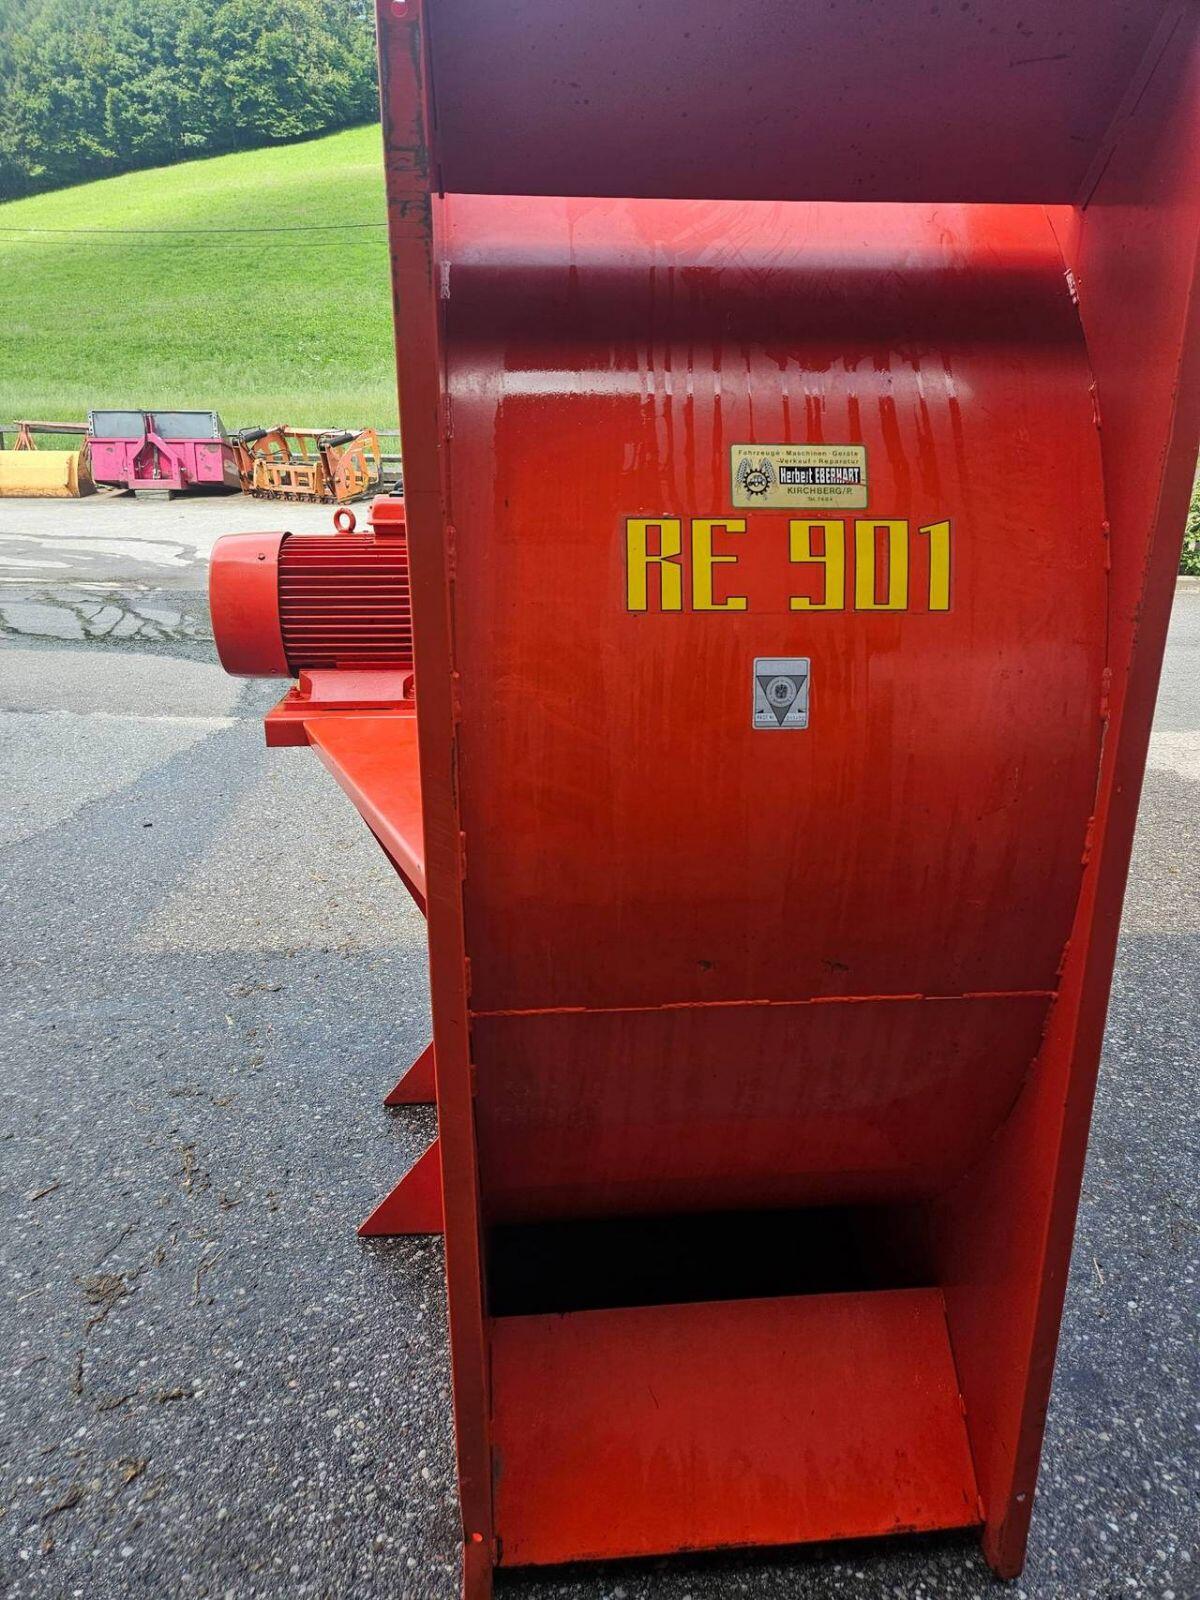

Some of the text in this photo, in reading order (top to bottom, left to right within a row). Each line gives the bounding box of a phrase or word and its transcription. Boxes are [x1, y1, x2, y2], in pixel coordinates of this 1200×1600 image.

[738, 449, 780, 457] Fahrzeuge
[818, 458, 859, 466] Reparatur
[815, 467, 859, 483] EBERHART
[625, 517, 951, 612] RE 901
